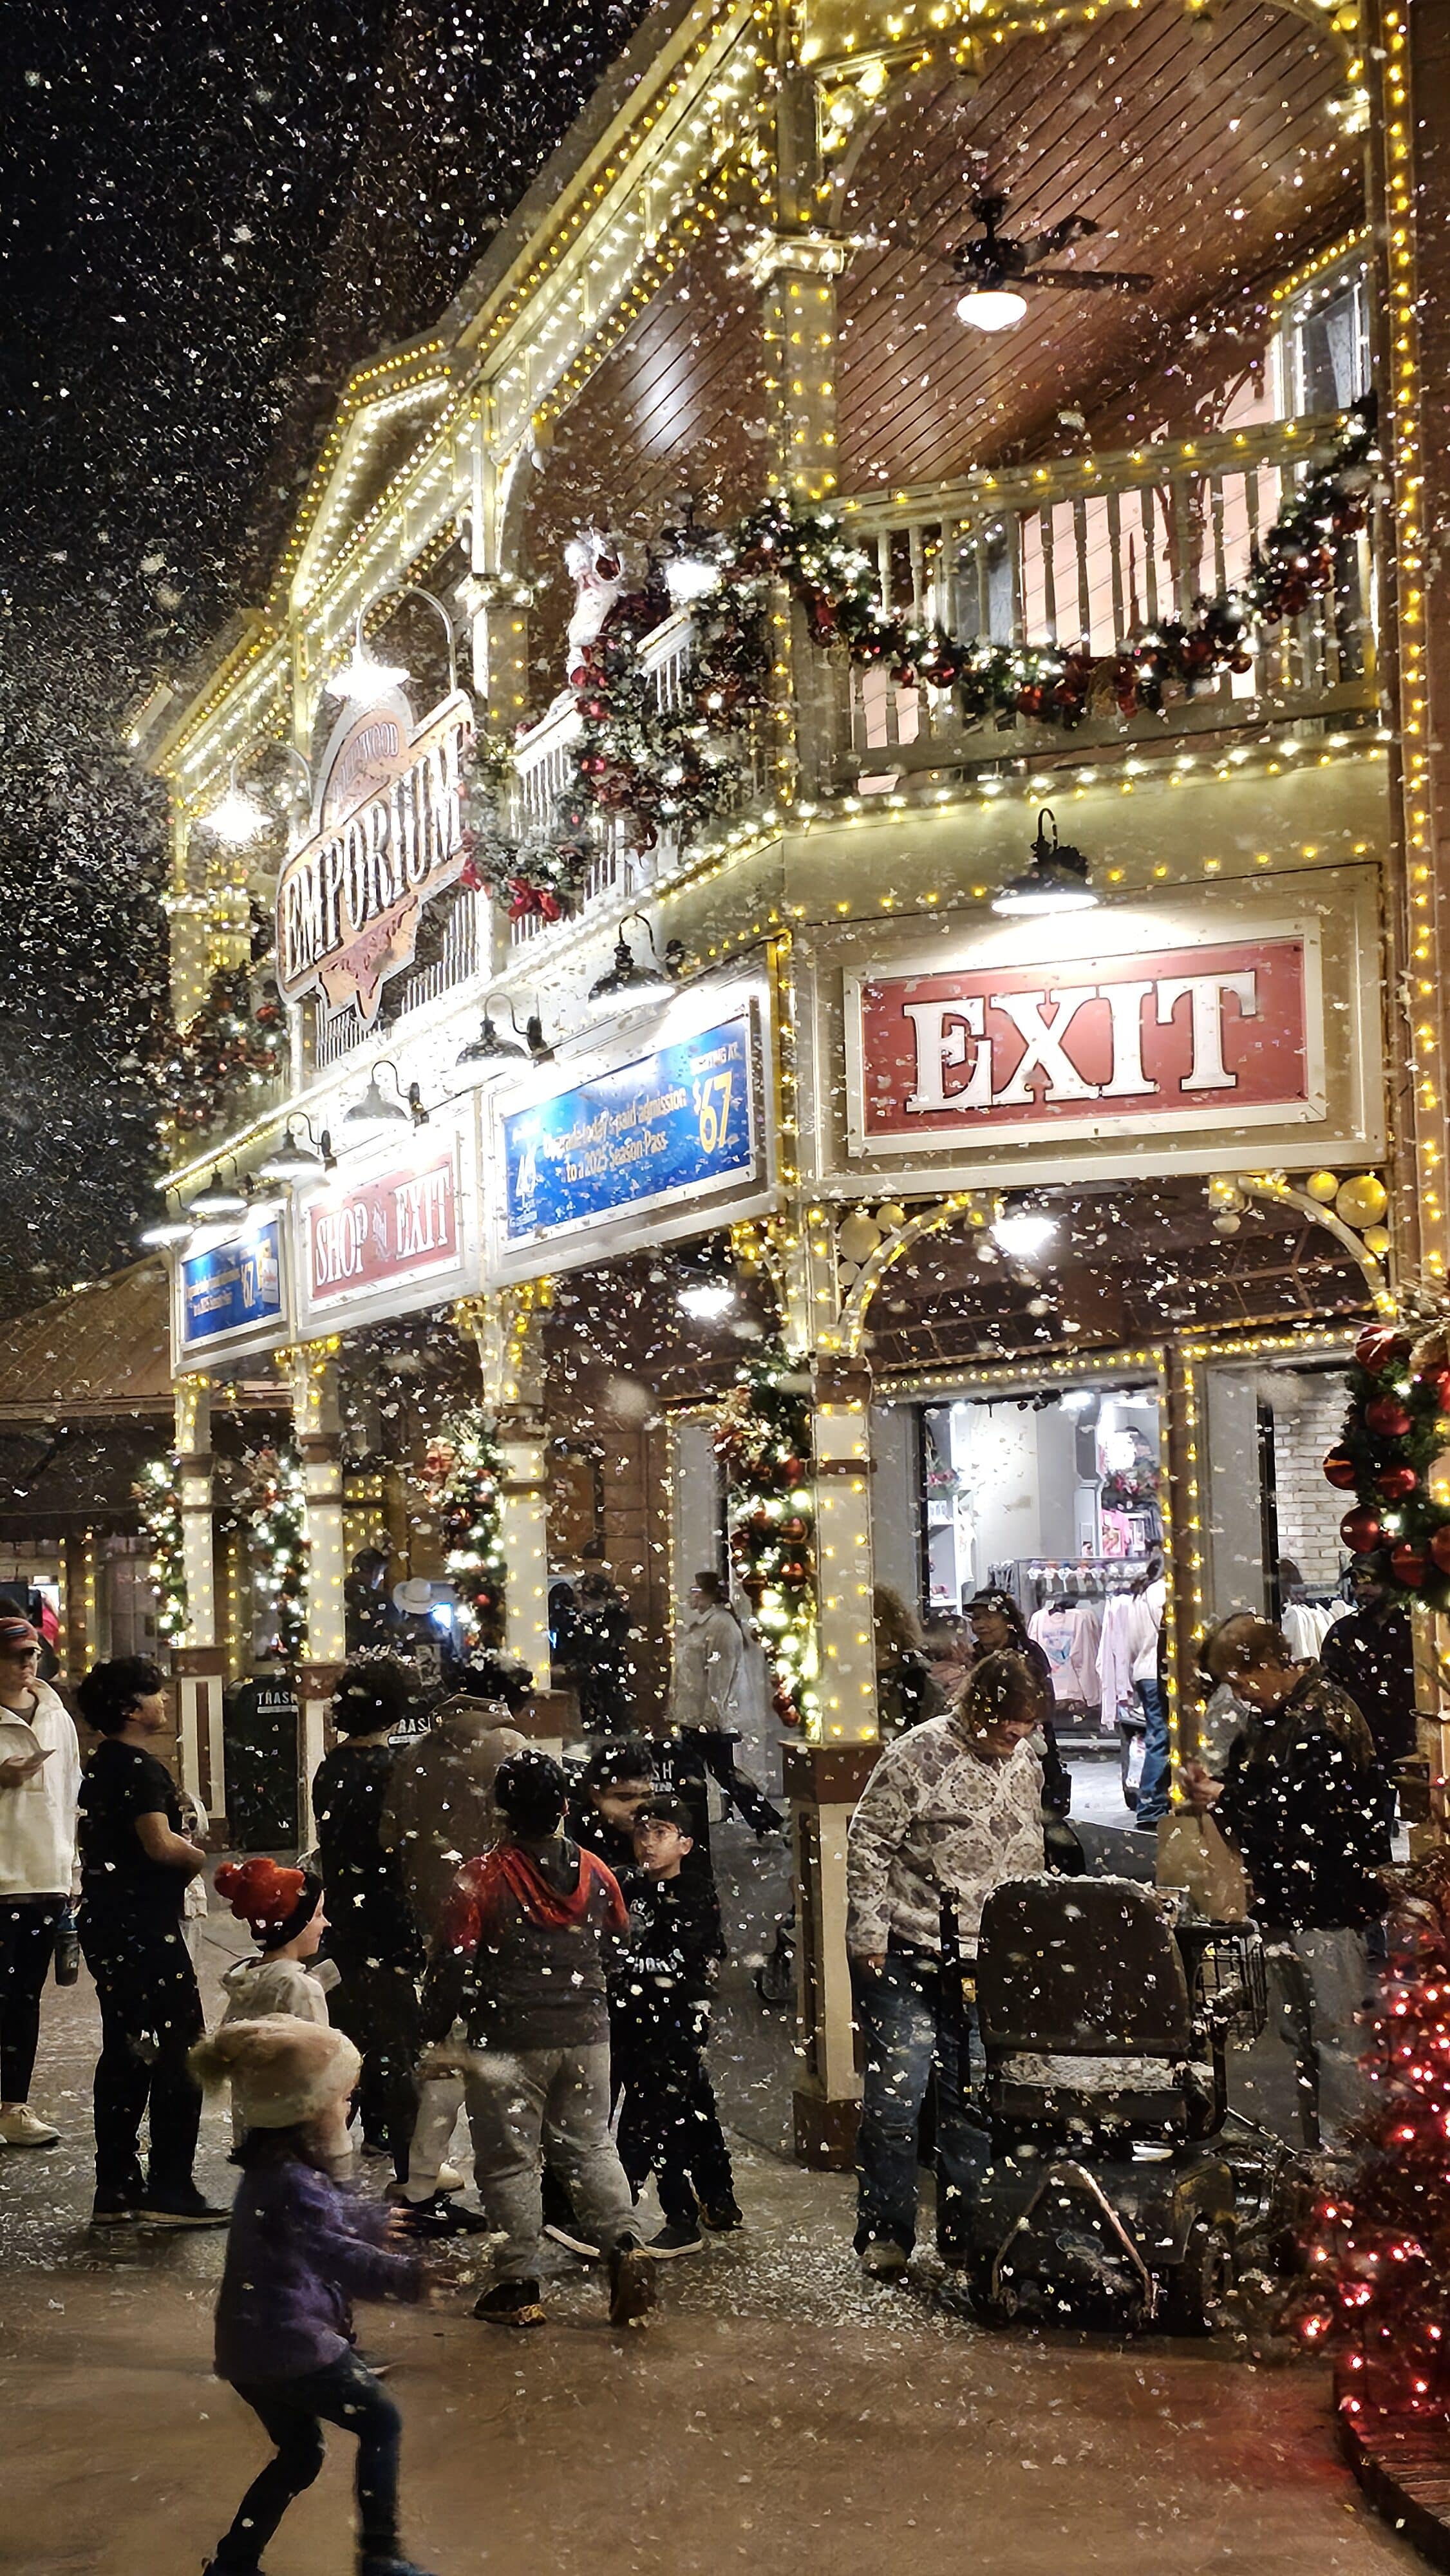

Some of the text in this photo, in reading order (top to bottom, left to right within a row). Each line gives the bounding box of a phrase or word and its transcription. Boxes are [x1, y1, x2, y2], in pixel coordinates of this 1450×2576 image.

[283, 721, 465, 983] EMPORIUM
[903, 970, 1257, 1112] EXIT
[565, 1160, 578, 1183] to
[643, 1128, 670, 1157] Pass
[315, 1202, 368, 1287] SHOP
[393, 1166, 449, 1262] EXIT
